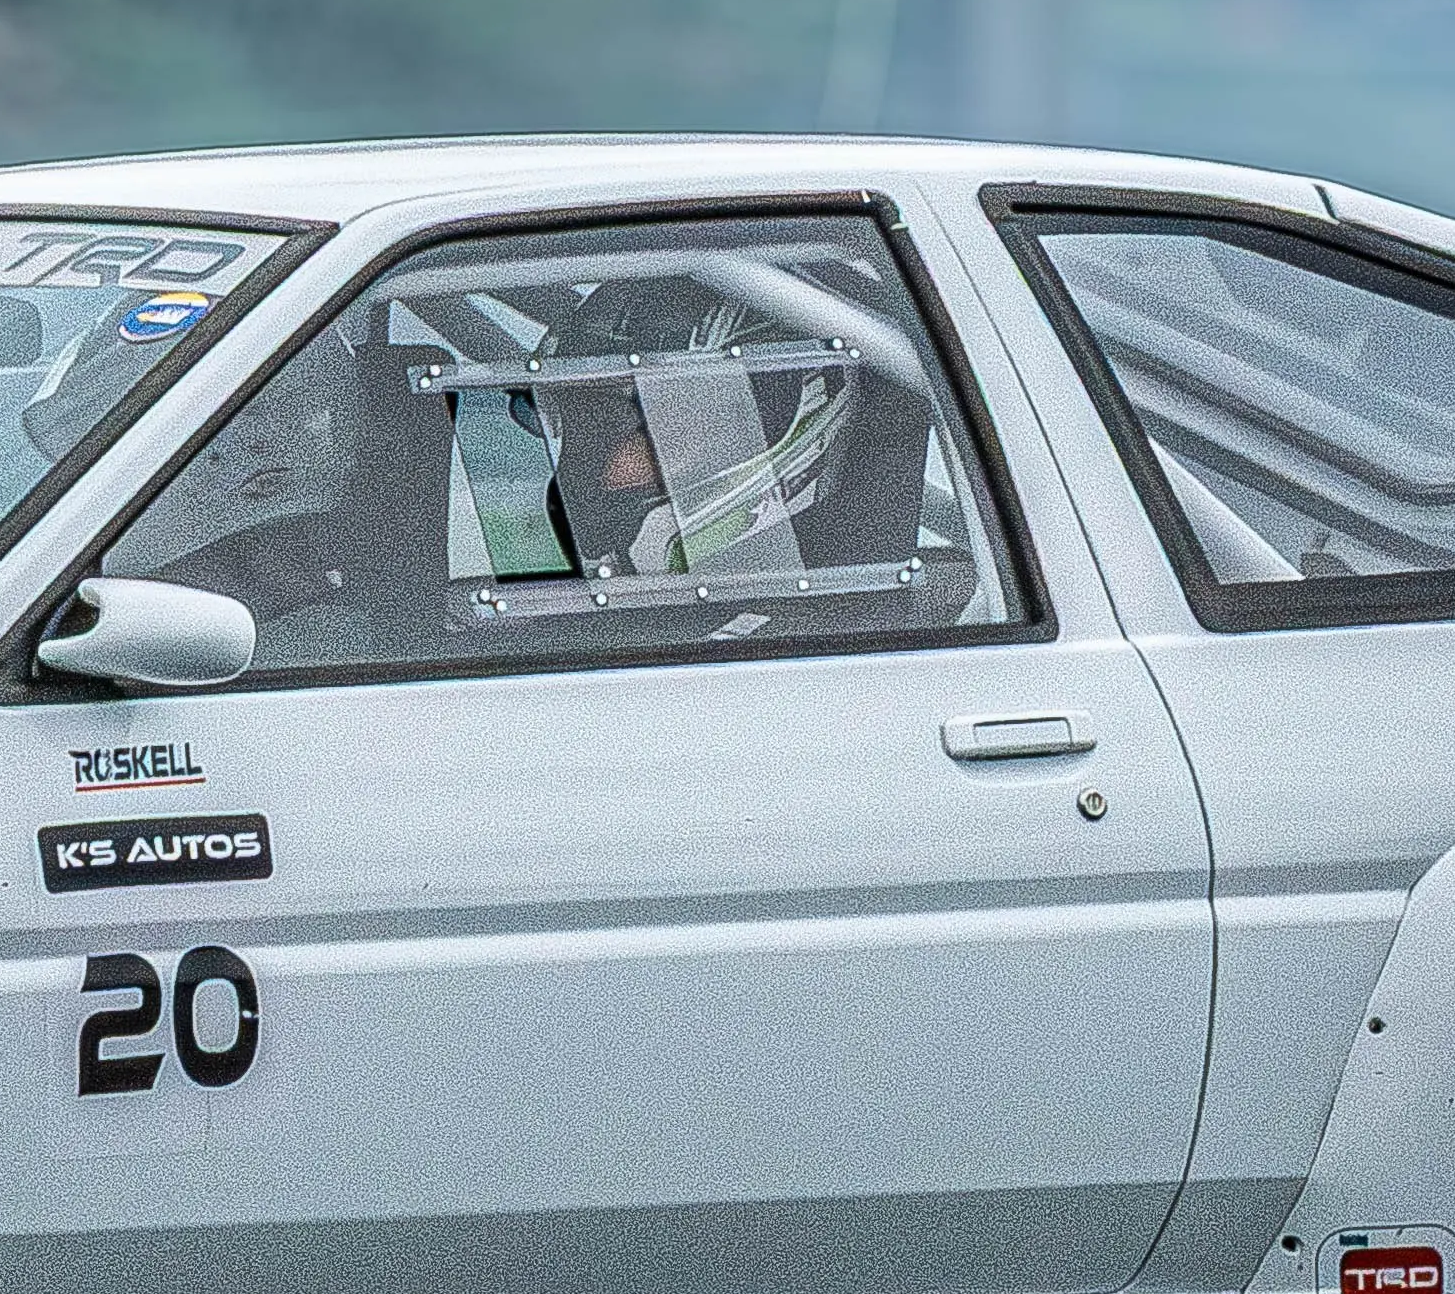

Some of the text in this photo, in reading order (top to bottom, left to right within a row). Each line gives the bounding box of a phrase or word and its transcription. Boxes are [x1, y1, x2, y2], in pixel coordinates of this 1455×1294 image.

[4, 231, 247, 287] TRD
[56, 832, 262, 870] K'S AUTOS
[78, 944, 260, 1097] 20
[1344, 1266, 1439, 1290] TRD
